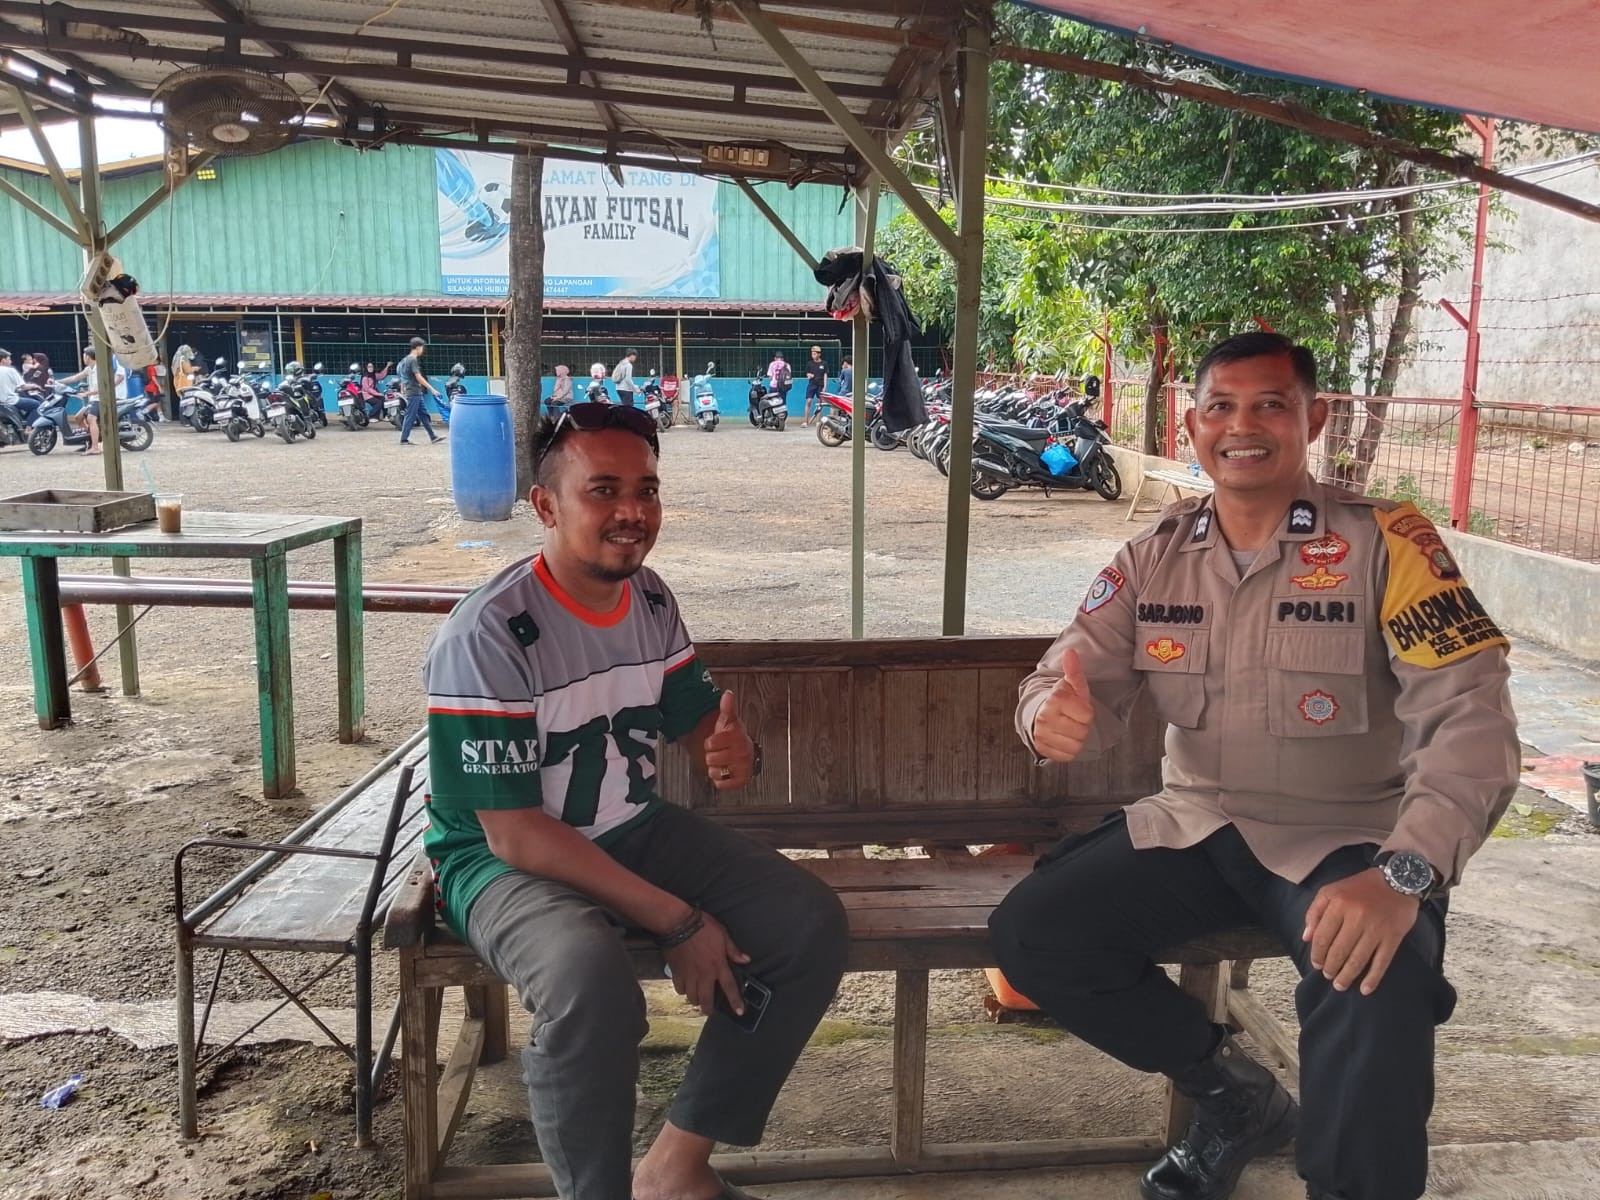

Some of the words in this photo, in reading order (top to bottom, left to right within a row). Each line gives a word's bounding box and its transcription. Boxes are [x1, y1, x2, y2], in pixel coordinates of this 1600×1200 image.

[604, 170, 672, 187] DTANG
[680, 172, 697, 187] DI
[543, 195, 598, 232] AYAN
[606, 196, 690, 241] FUTSAL
[583, 222, 637, 241] FAMILY
[447, 277, 472, 285] UNTUK
[1137, 603, 1204, 624] SARJONO
[1278, 600, 1355, 623] POLRI
